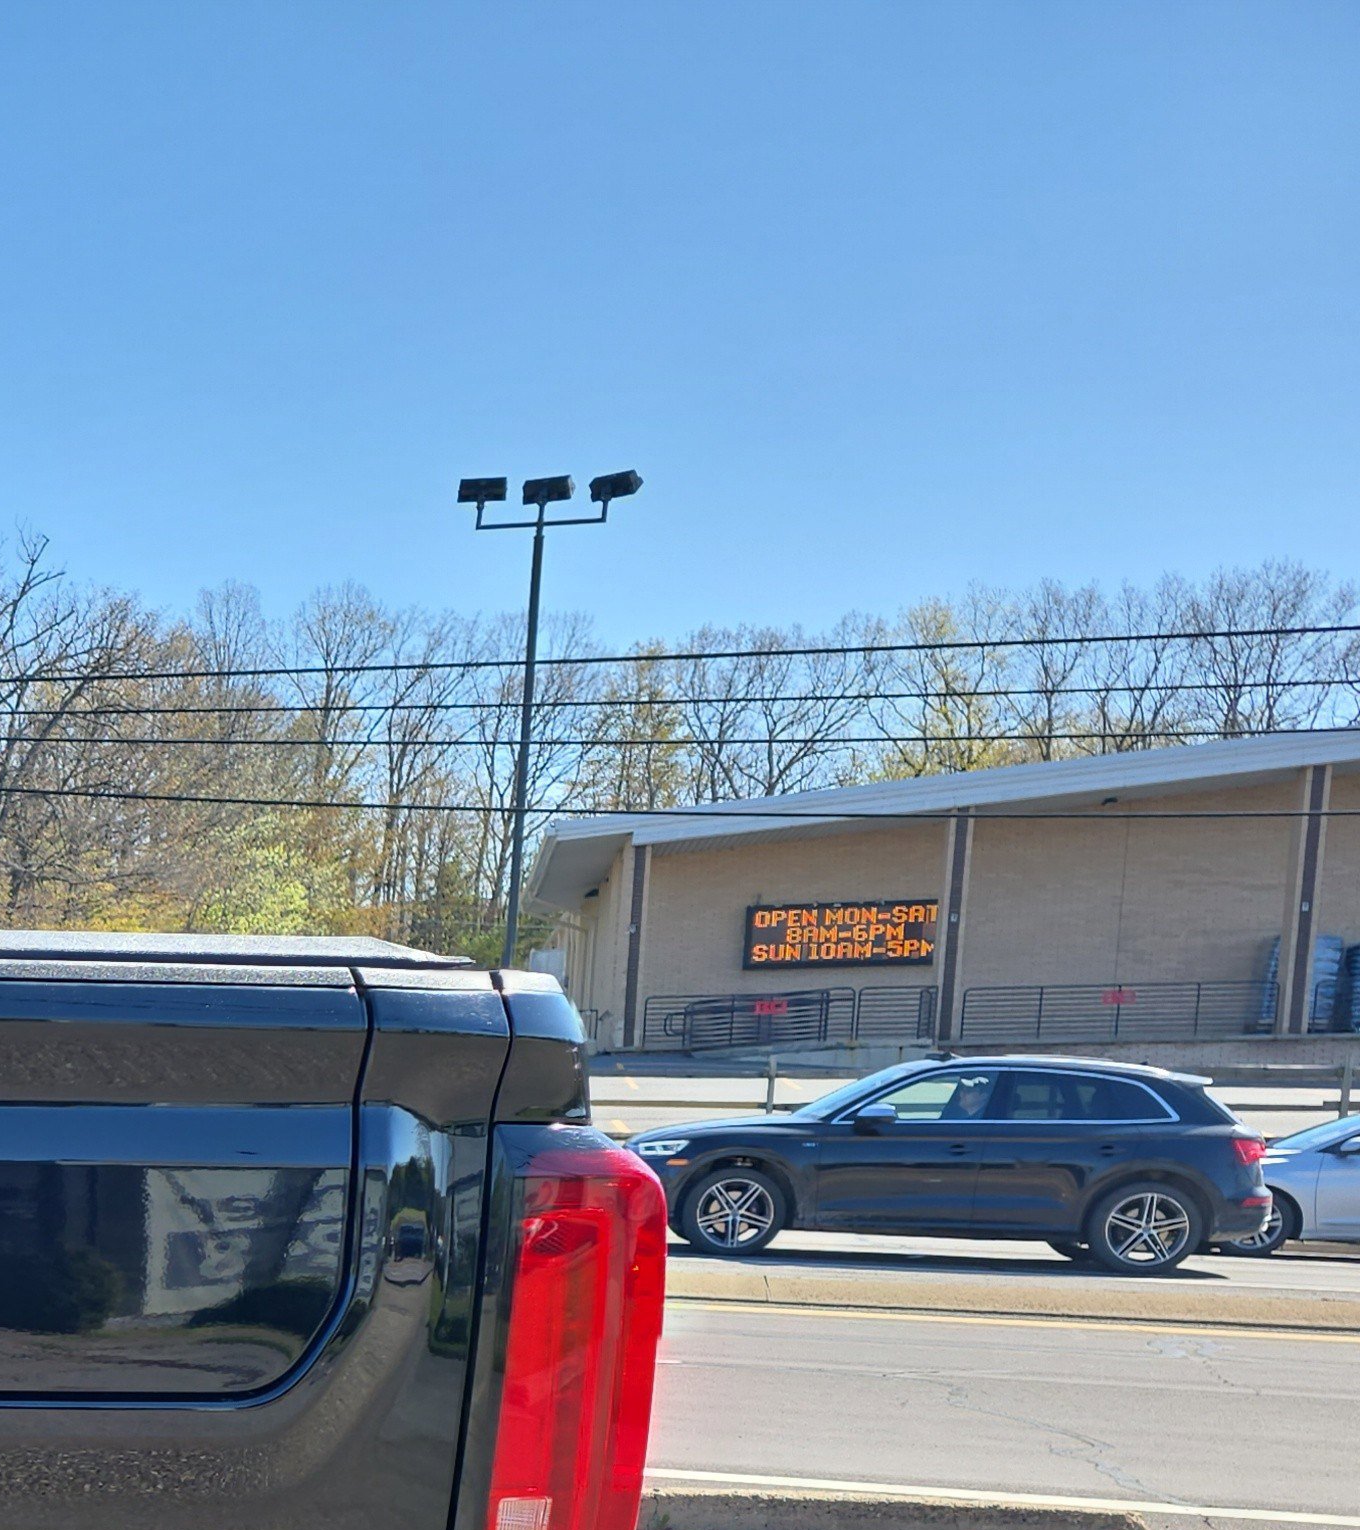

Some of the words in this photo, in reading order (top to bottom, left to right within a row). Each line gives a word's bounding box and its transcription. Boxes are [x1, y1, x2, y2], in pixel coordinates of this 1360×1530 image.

[755, 908, 818, 928] OPEN
[825, 904, 939, 926] MON-SAT
[786, 923, 905, 944] 8AM-6PM
[752, 943, 802, 962] SUN
